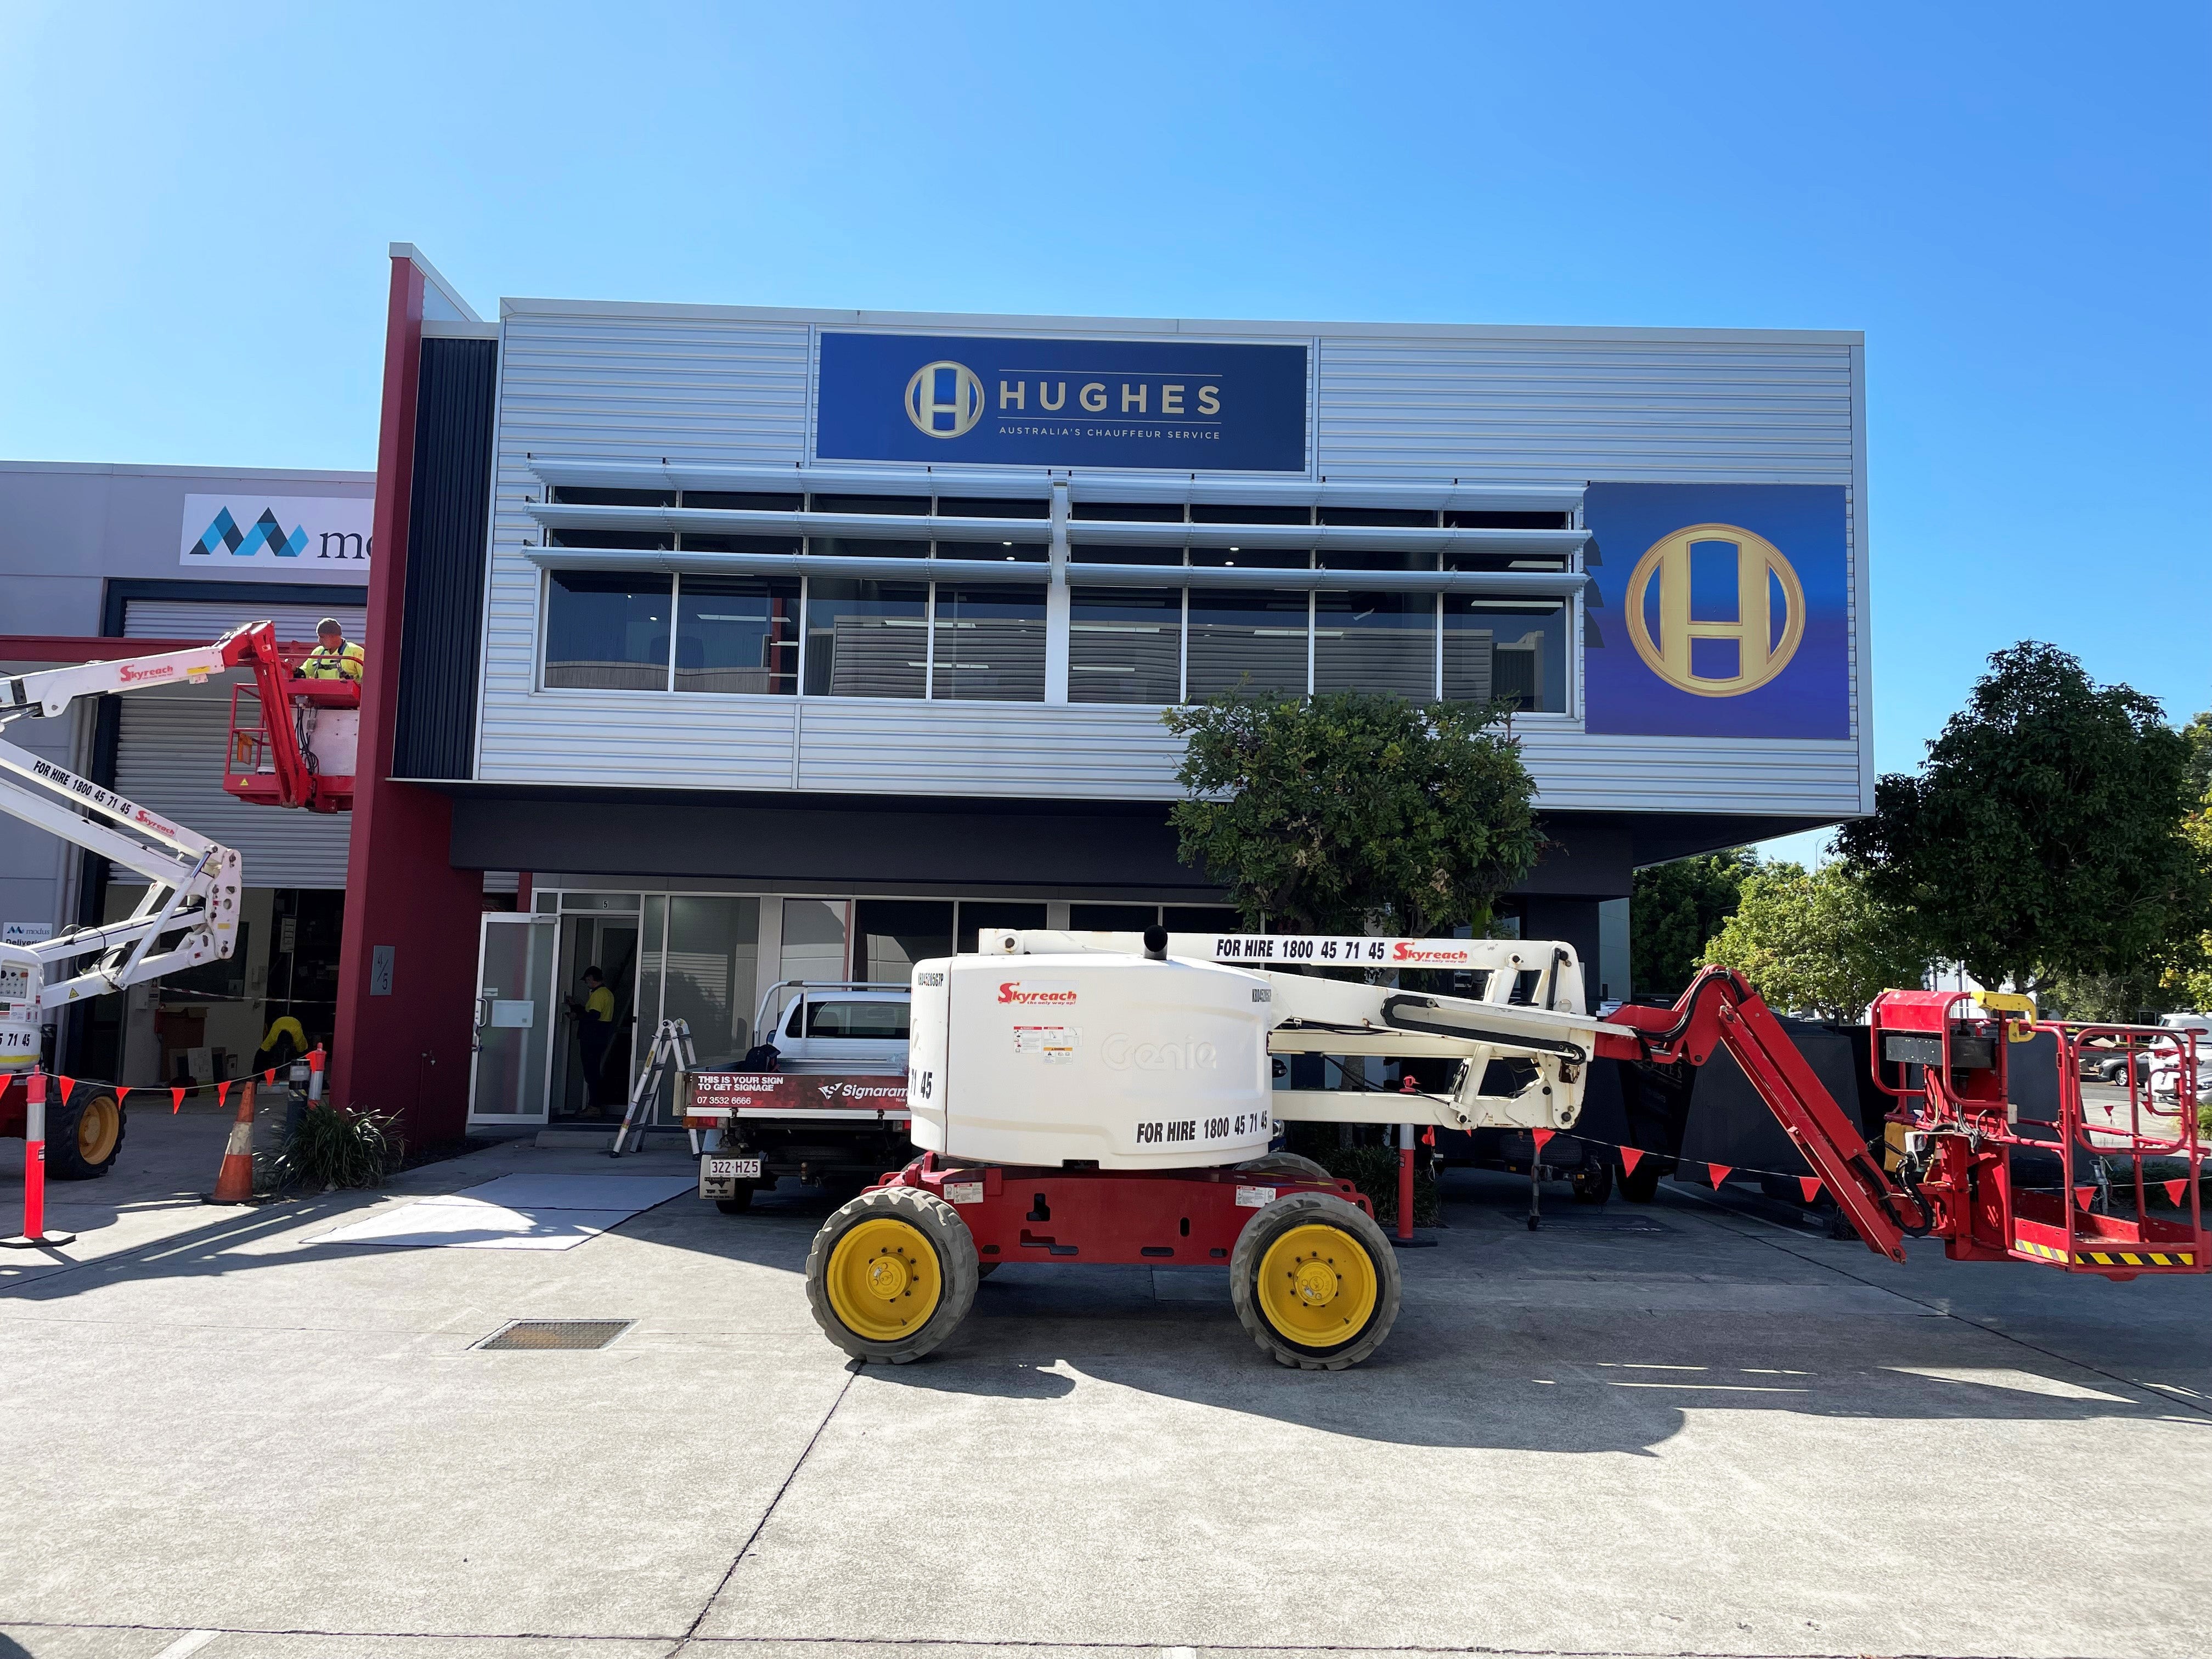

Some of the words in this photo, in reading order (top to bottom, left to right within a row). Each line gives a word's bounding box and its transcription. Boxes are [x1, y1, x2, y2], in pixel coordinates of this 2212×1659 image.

[1000, 380, 1221, 415] HUGHES
[999, 426, 1081, 436] AUSTRALIA'S
[1087, 428, 1161, 438] CHAUFFEUR
[1167, 431, 1220, 440] SERVICE
[120, 664, 173, 682] Skyreach
[33, 760, 51, 777] FOR
[50, 768, 70, 786] HIRE
[72, 779, 92, 795] 1800
[94, 790, 106, 802] 45
[107, 795, 118, 808] 71
[120, 803, 131, 815] 45
[136, 810, 175, 836] Skyreach
[603, 900, 608, 909] 5
[1216, 939, 1241, 956] FOR
[1244, 939, 1274, 957] HIRE
[1283, 940, 1313, 958] 1800
[1321, 941, 1337, 958] 45
[1345, 941, 1359, 959] 71
[1368, 942, 1385, 960] 45
[1392, 942, 1468, 961] Skyreach
[997, 983, 1077, 1004] Skyreach
[8, 1033, 18, 1046] 71
[22, 1034, 30, 1046] 45
[1101, 1032, 1216, 1071] Genie
[734, 1084, 774, 1092] SIGNAGE
[842, 1084, 907, 1099] Signaram
[911, 1068, 917, 1096] 71
[921, 1071, 933, 1099] 45
[1137, 1123, 1163, 1143] FOR
[1167, 1121, 1196, 1142] HIRE
[1204, 1117, 1229, 1139] 1800
[1234, 1115, 1245, 1135] 45
[1250, 1113, 1257, 1133] 71
[1261, 1110, 1267, 1130] 45
